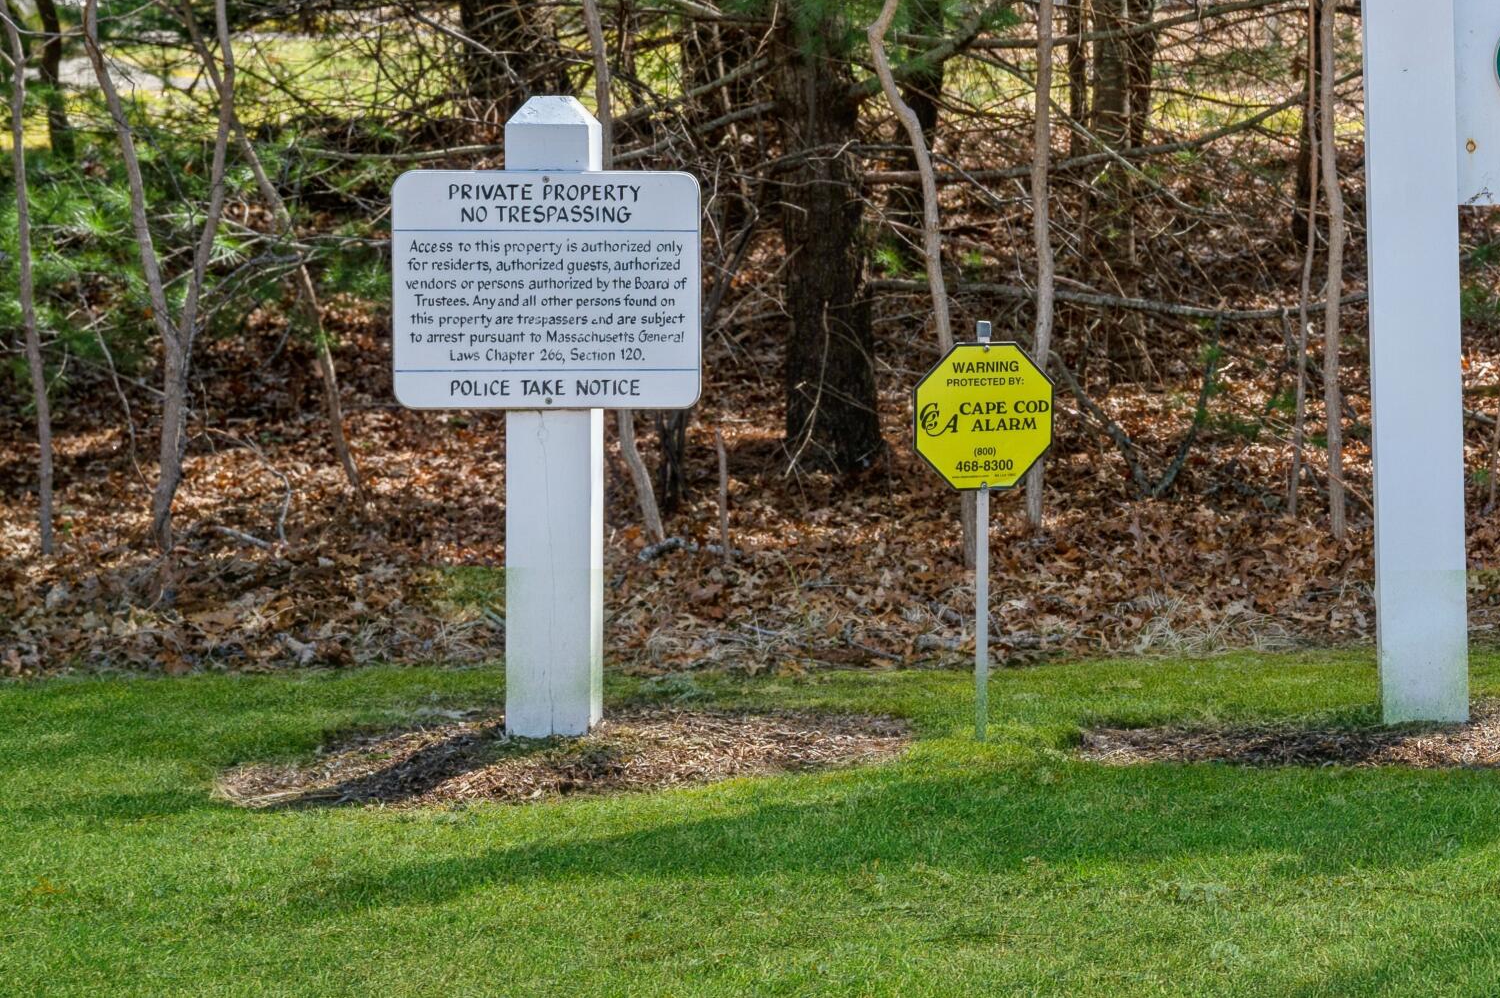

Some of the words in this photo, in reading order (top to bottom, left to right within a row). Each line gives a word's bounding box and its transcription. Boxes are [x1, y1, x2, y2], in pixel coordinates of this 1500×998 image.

[449, 184, 533, 200] PRIVATE
[543, 184, 641, 202] PROPERTY
[461, 206, 487, 222] NO
[495, 205, 632, 223] TRESPASSING
[410, 239, 453, 253] Access
[459, 242, 471, 252] to
[475, 239, 500, 252] this
[504, 242, 562, 256] property
[567, 238, 578, 252] is
[581, 240, 651, 252] authorized
[656, 240, 683, 256] only
[408, 258, 428, 271] for
[496, 258, 564, 272] authorized
[567, 261, 611, 275] guests,
[614, 257, 681, 271] authorized
[406, 278, 457, 290] vendors
[461, 281, 474, 289] or
[478, 280, 525, 292] persons
[529, 277, 593, 290] authorized
[596, 277, 610, 292] by
[613, 277, 632, 290] the
[634, 277, 670, 290] Board
[674, 277, 687, 290] of
[414, 294, 470, 307] Trustees.
[473, 294, 496, 310] Any
[498, 294, 520, 307] and
[523, 295, 537, 306] all
[541, 295, 573, 307] other
[576, 297, 621, 309] persons
[624, 294, 658, 307] found
[660, 297, 676, 306] on
[410, 312, 434, 325] this
[439, 314, 492, 328] property
[495, 316, 514, 325] are
[517, 314, 588, 327] trespassers
[617, 315, 637, 325] are
[640, 312, 686, 327] subject
[410, 332, 422, 343] to
[427, 332, 466, 343] arrest
[470, 333, 526, 347] pursuant
[529, 332, 542, 343] to
[546, 330, 635, 343] Massachusetts
[638, 330, 685, 343] General
[449, 349, 480, 361] Laws
[485, 348, 535, 363] Chapter
[570, 348, 616, 361] Section
[621, 348, 646, 361] 120.
[952, 361, 1019, 373] WARNING
[450, 379, 510, 396] POLICE
[520, 379, 566, 396] TAKE
[576, 379, 641, 396] NOTICE
[947, 378, 1006, 387] PROTECTED
[1009, 377, 1024, 386] BY:
[959, 401, 1008, 415] CAPE
[1014, 400, 1049, 413] COD
[971, 417, 1037, 432] ALARM
[974, 447, 997, 458] (800)
[956, 459, 1014, 472] 468-8300
